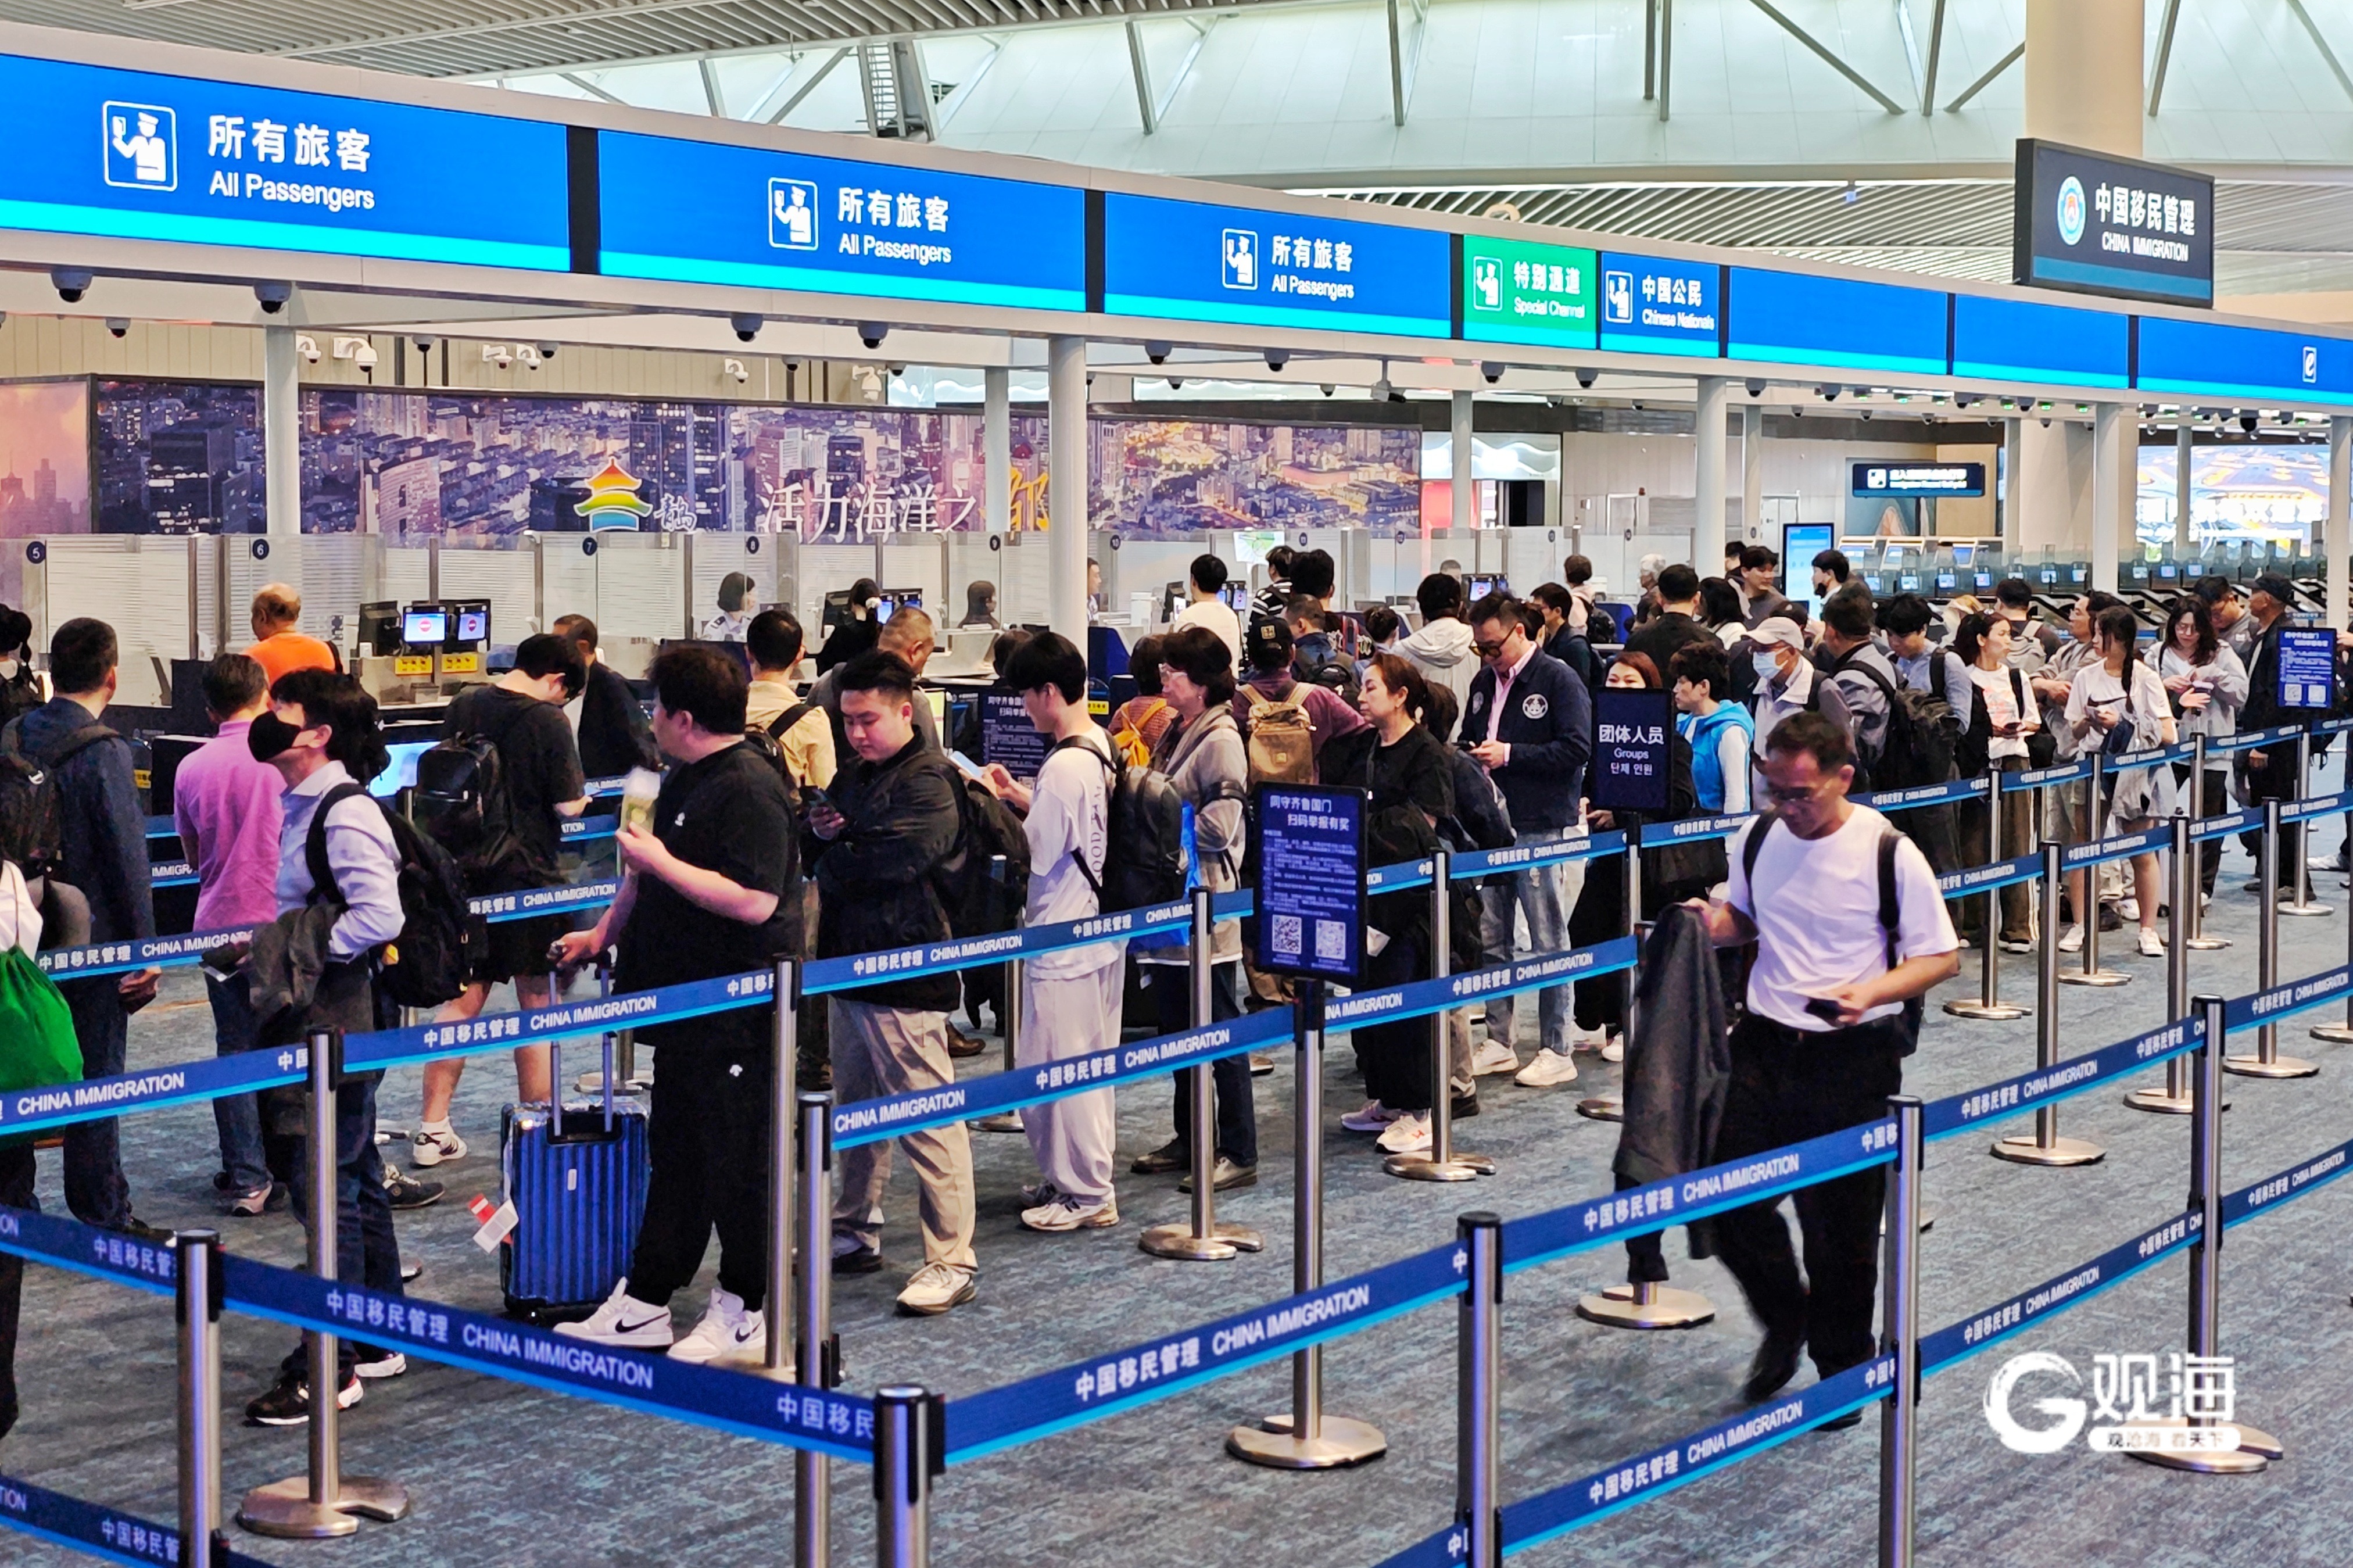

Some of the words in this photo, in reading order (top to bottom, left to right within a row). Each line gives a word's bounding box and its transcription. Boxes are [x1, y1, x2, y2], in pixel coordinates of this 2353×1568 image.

[207, 114, 372, 173] 所有旅客
[209, 171, 239, 198] All
[246, 174, 375, 213] Passengers
[837, 187, 950, 234] 所有旅客
[2095, 182, 2196, 237] 中国移民管理
[839, 233, 859, 255] All
[864, 235, 952, 266] Passengers
[1271, 235, 1353, 273] 所有旅客
[2102, 231, 2130, 255] CHINA
[2133, 235, 2189, 263] IMMIGRATION
[1271, 274, 1287, 293] All
[1290, 275, 1355, 302] Passengers
[1513, 260, 1581, 296] 特别通道
[1642, 275, 1703, 307] 中国公民
[1514, 298, 1548, 317] Special
[1549, 300, 1585, 320] Channel
[1642, 310, 1675, 327] Chinese
[1678, 312, 1716, 331] Nationals
[33, 547, 40, 559] 5
[257, 543, 264, 556] 6
[586, 541, 592, 553] 7
[750, 540, 756, 550] 8
[1599, 725, 1664, 744] 团体人员
[1614, 746, 1649, 760] Groups
[1633, 763, 1653, 776] 인원
[1288, 814, 1350, 831] 扫码举报有奖
[523, 893, 553, 908] CHINA
[555, 882, 616, 903] IMMIGRATION
[1073, 914, 1133, 938] 中国移民管理
[1146, 909, 1172, 923] CHINA
[39, 944, 132, 970] 中国移民管理
[142, 940, 181, 957] CHINA
[853, 950, 923, 975] 中国移民管理
[930, 944, 961, 962] CHINA
[962, 934, 1023, 957] IMMIGRATION
[1452, 969, 1511, 996] 中国移民管理
[1517, 965, 1542, 980] CHINA
[1542, 952, 1593, 975] IMMIGRATION
[1342, 992, 1403, 1017] IMMIGRATION
[2252, 990, 2293, 1016] 中国移民管理
[2295, 985, 2313, 1001] CHINA
[2313, 971, 2349, 996] IMMIGRATION
[424, 1016, 521, 1048] 中国移民管理
[530, 1010, 572, 1031] CHINA
[573, 995, 657, 1023] IMMIGRATION
[1036, 1054, 1116, 1090] 中国移民管理
[1124, 1046, 1159, 1068] CHINA
[1161, 1028, 1230, 1060] IMMIGRATION
[2136, 1026, 2184, 1059] 中国移民管理
[17, 1090, 71, 1115] CHINA
[74, 1072, 185, 1107] IMMIGRATION
[1961, 1084, 2019, 1119] 中国移民管理
[2023, 1076, 2048, 1097] CHINA
[2048, 1059, 2098, 1089] IMMIGRATION
[834, 1108, 878, 1133] CHINA
[879, 1089, 965, 1123] IMMIGRATION
[1584, 1186, 1674, 1232] 中国移民管理
[1683, 1178, 1722, 1204] CHINA
[1723, 1154, 1800, 1191] IMMIGRATION
[2248, 1176, 2289, 1207] 中国移民管理
[2292, 1166, 2309, 1187] CHINA
[2310, 1150, 2345, 1180] IMMIGRATION
[94, 1236, 177, 1278] 中国移民管
[2138, 1218, 2185, 1259] 中国移民管理
[1453, 1248, 1468, 1275] 中
[1964, 1302, 2021, 1345] 中国移民管理
[2026, 1291, 2050, 1316] CHINA
[2051, 1265, 2100, 1305] IMMIGRATION
[326, 1289, 448, 1344] 中国移民管理
[463, 1323, 521, 1358] CHINA
[524, 1337, 654, 1390] IMMIGRATION
[1075, 1337, 1200, 1402] 中国移民管理
[1212, 1319, 1266, 1355] CHINA
[1267, 1284, 1370, 1337] IMMIGRATION
[1589, 1449, 1679, 1505] 中国移民管理
[1687, 1436, 1726, 1464] CHINA
[1727, 1400, 1803, 1450] IMMIGRATION
[102, 1517, 180, 1562] 中国移民管
